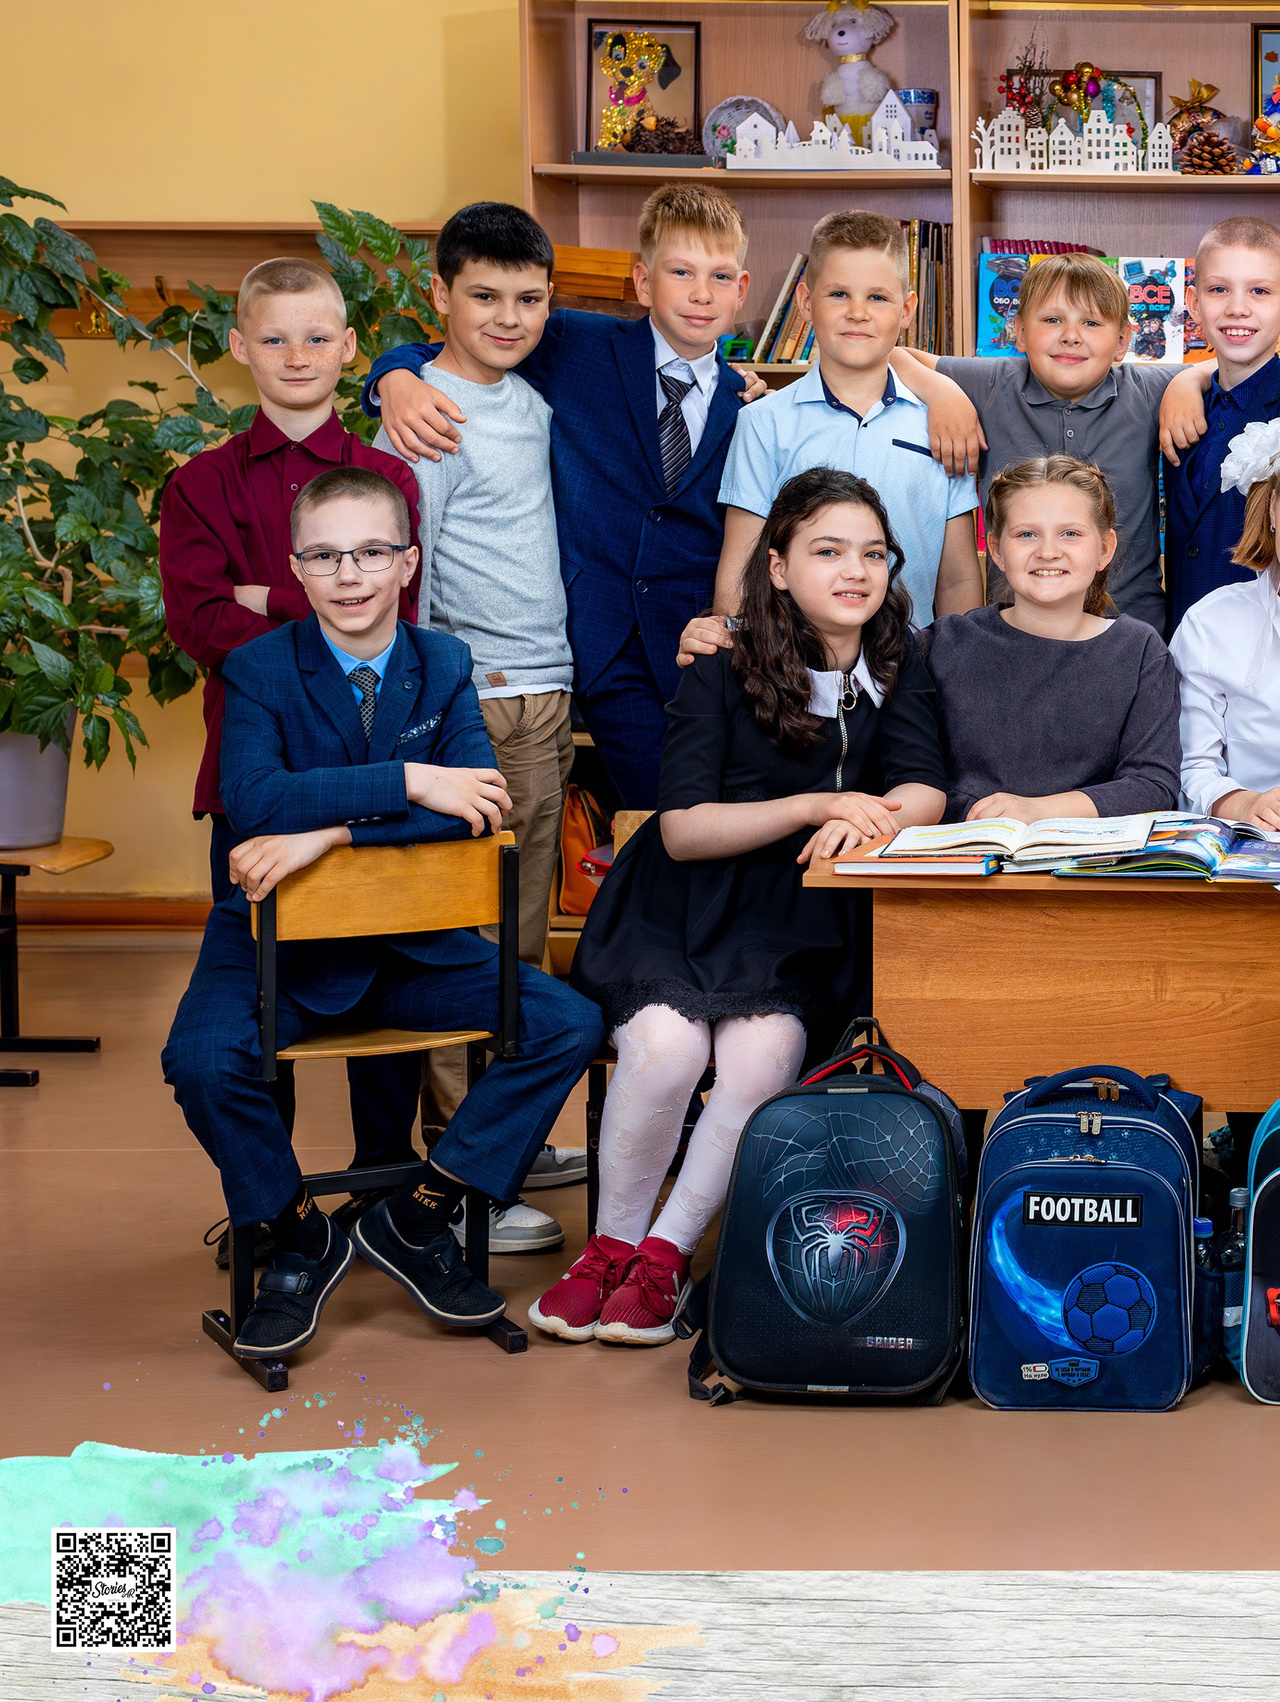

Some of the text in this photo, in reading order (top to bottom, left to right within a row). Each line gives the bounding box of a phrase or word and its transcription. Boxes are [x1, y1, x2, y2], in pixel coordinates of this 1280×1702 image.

[994, 279, 1022, 298] ВС
[1130, 285, 1170, 304] ВСЕ
[299, 1198, 314, 1220] NIK
[412, 1190, 438, 1210] NIKE
[1028, 1196, 1138, 1223] FOOTBALL
[866, 1336, 914, 1350] SPIDER
